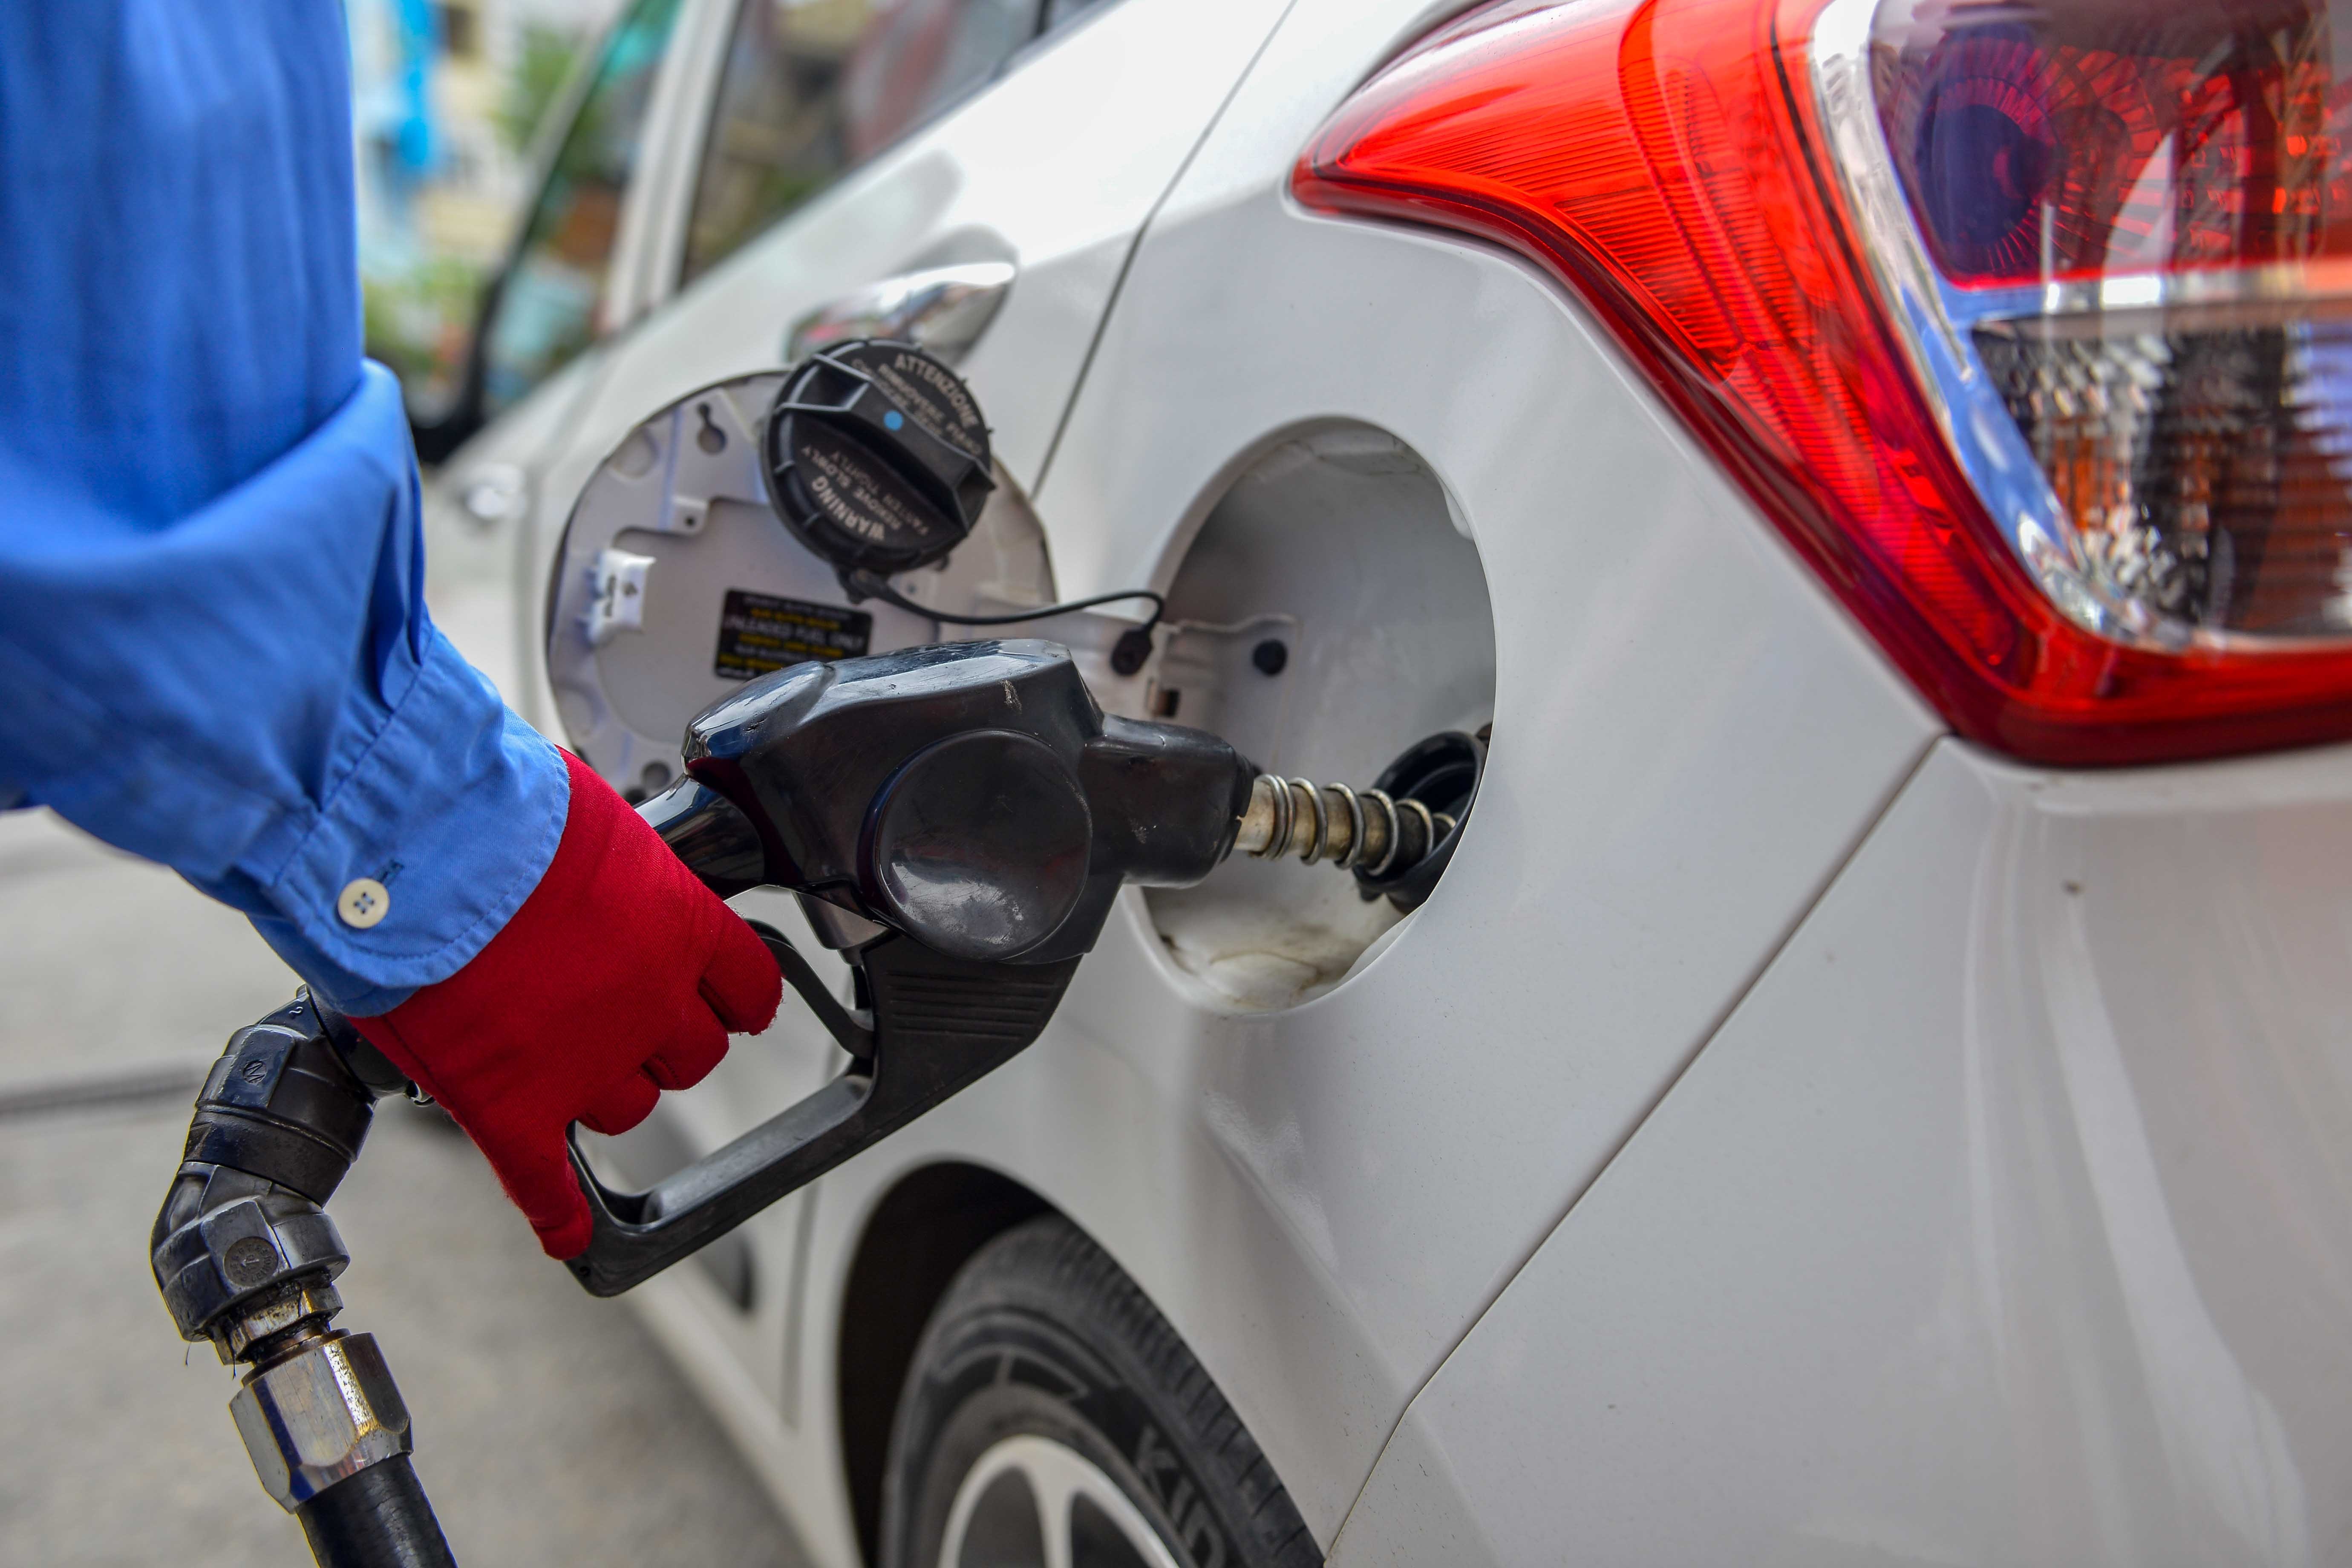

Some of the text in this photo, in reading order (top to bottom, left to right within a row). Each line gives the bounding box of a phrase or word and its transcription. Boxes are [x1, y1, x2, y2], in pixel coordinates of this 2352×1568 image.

[895, 353, 979, 428] ATTENZIONE
[802, 445, 901, 530] REMOVE SLOWLY
[811, 476, 885, 540] WARNING
